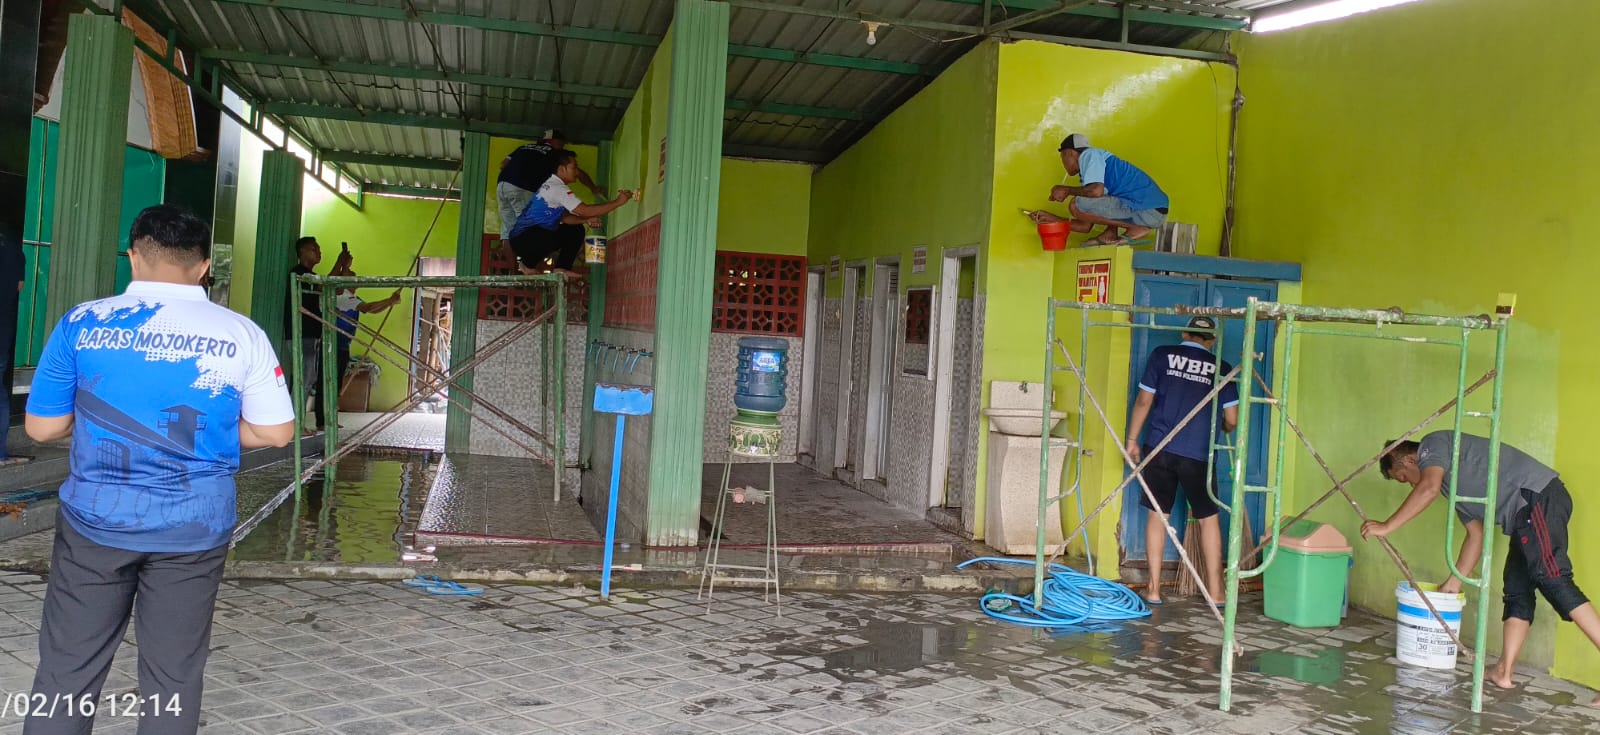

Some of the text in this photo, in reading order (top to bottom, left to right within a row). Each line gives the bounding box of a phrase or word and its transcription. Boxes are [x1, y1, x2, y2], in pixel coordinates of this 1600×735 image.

[77, 329, 237, 358] LAPAS MOJOKERTO
[1167, 353, 1216, 376] WBP
